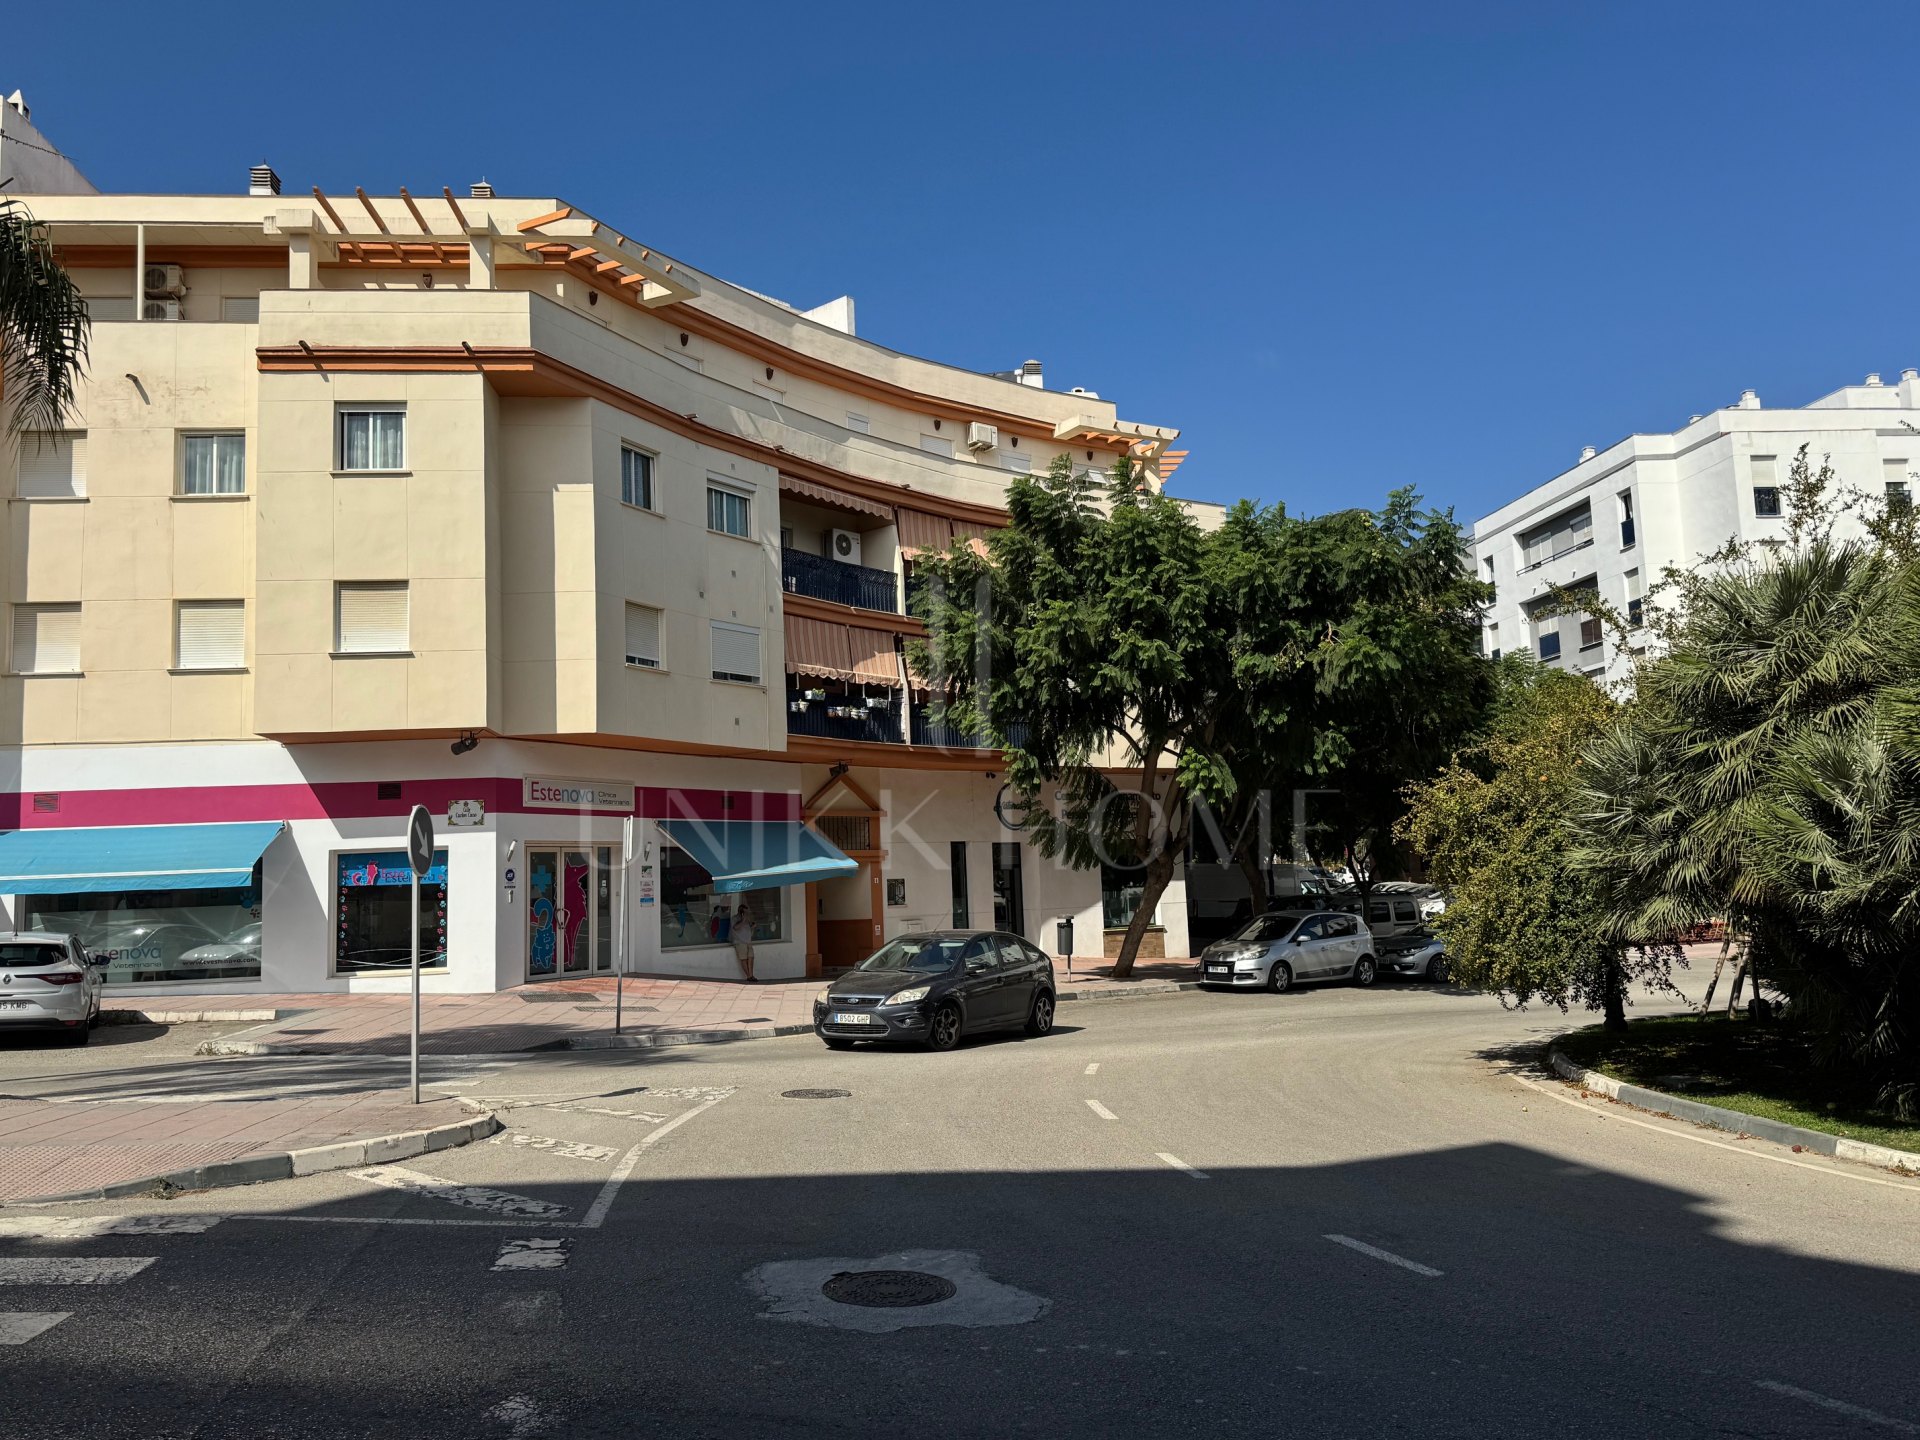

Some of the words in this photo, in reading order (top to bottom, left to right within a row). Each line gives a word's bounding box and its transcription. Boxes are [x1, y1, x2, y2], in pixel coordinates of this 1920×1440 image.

[530, 781, 595, 804] Estenova
[839, 1014, 856, 1023] 8502
[856, 1015, 870, 1023] GHP
